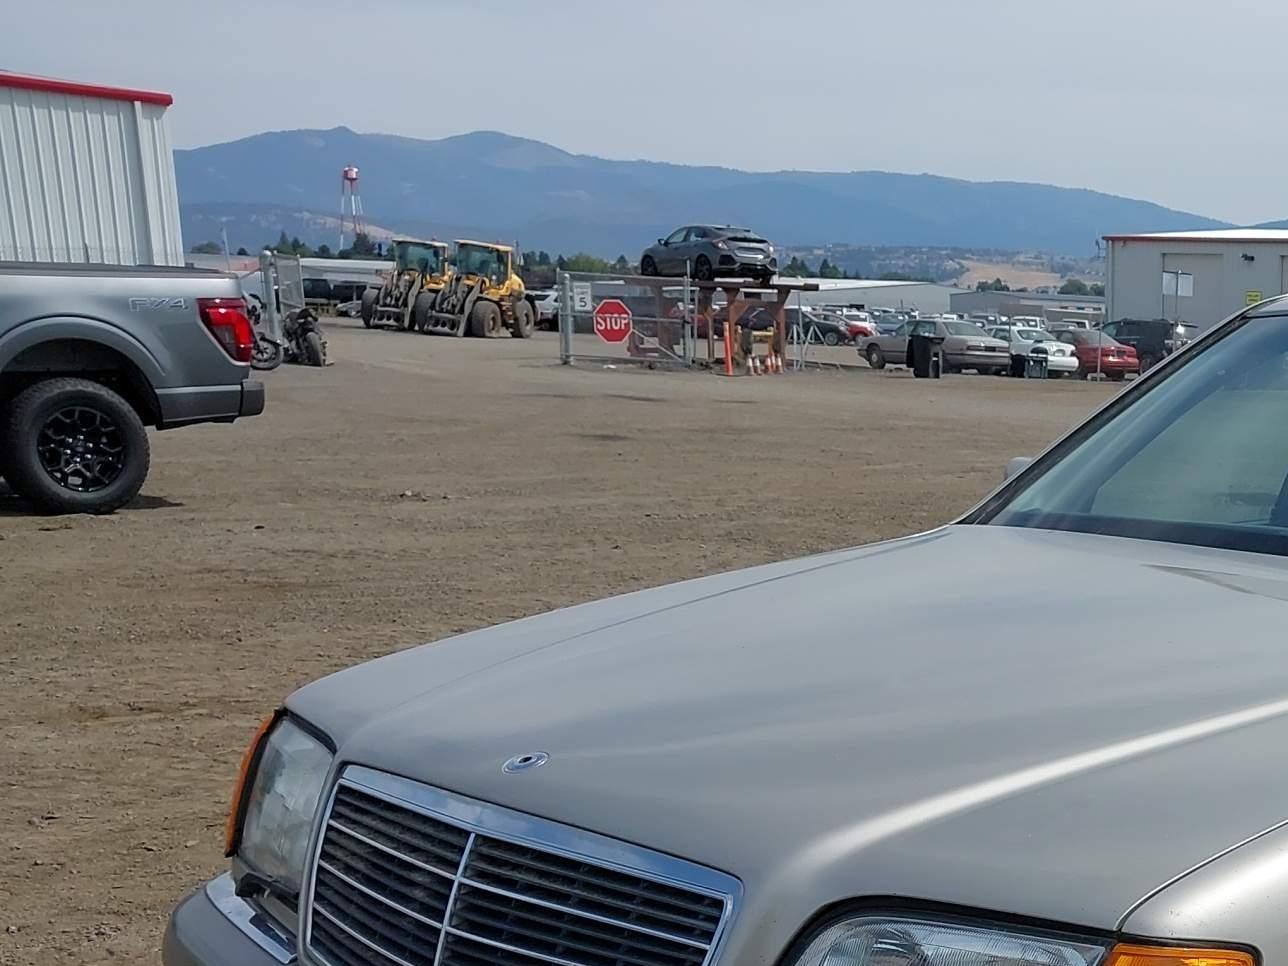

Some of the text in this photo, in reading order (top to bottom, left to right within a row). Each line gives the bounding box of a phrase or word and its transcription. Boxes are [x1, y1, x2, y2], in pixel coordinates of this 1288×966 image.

[128, 297, 189, 312] FX4
[578, 297, 588, 308] 5
[597, 313, 629, 330] STOP
